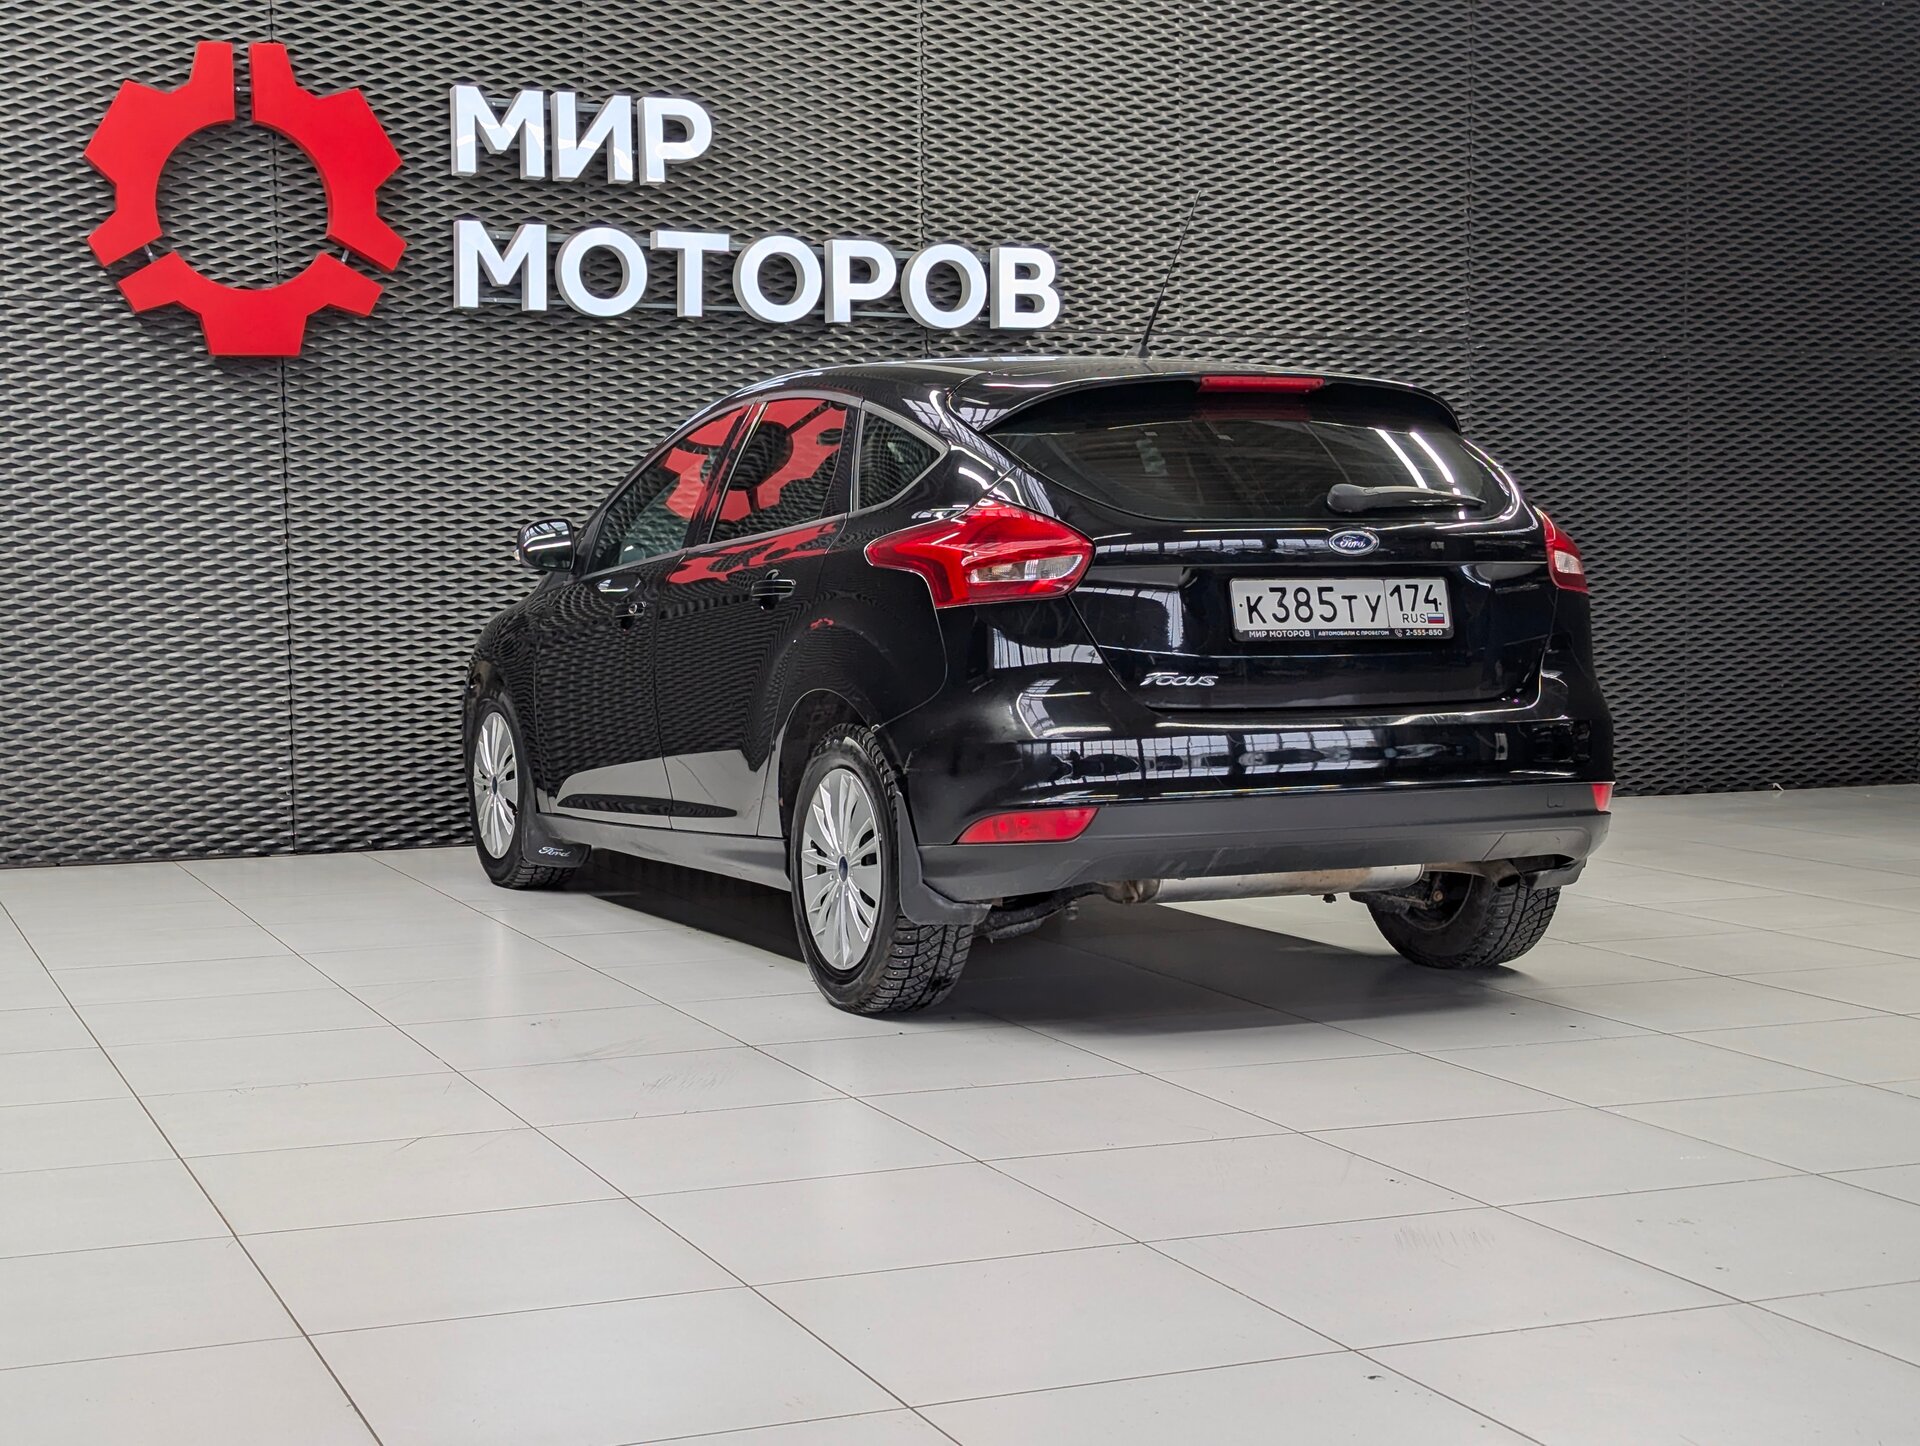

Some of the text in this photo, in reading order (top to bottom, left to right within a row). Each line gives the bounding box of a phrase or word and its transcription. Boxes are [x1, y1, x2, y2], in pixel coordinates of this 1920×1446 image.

[450, 84, 712, 185] МИР
[453, 219, 1060, 330] МОТОРОВ
[1339, 536, 1367, 549] Ford
[1246, 584, 1439, 624] К385ТУ 174
[1402, 613, 1426, 623] RUS
[1249, 630, 1267, 638] МИР
[1269, 629, 1310, 638] МОТОРОВ
[1405, 628, 1443, 636] 2-555-850
[538, 846, 571, 857] Ford
